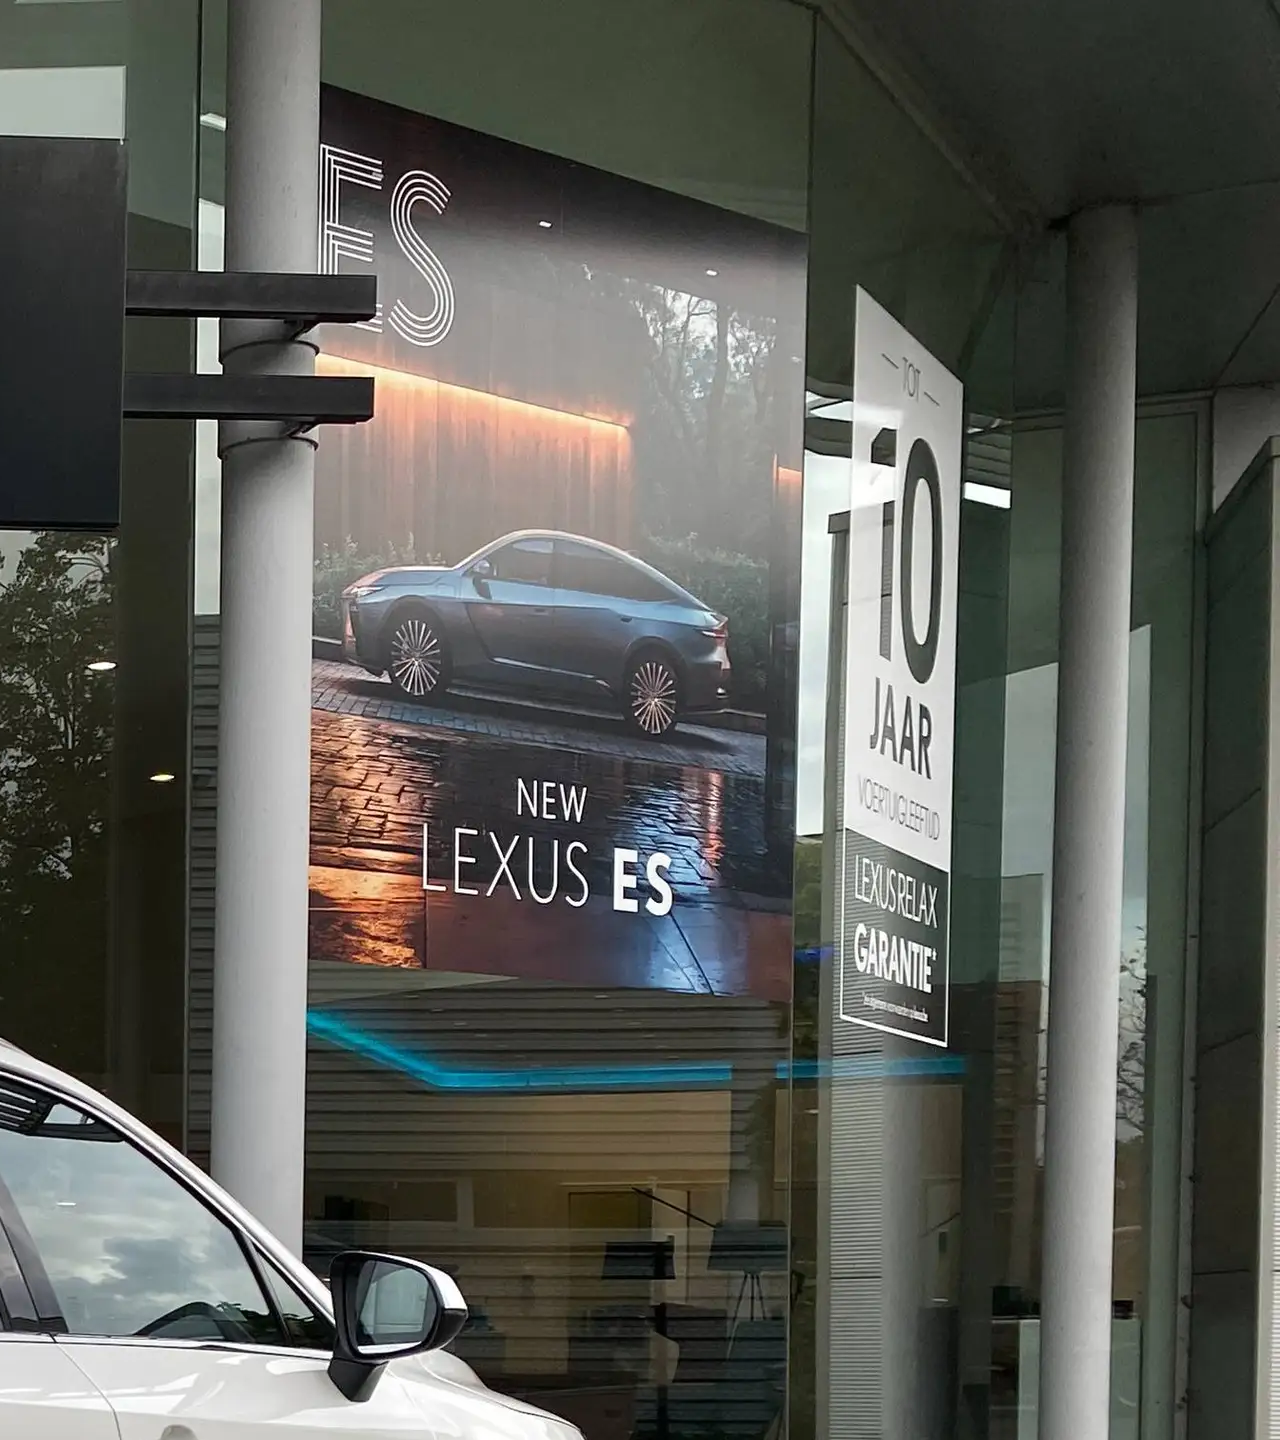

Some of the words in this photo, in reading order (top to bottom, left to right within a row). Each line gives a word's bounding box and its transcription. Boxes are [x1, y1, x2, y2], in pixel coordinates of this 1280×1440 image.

[317, 143, 455, 347] ES
[902, 356, 921, 404] TOT
[870, 427, 943, 684] 10
[870, 677, 932, 780] JAAR
[517, 777, 588, 824] NEW
[422, 823, 589, 908] LEXUS
[613, 847, 674, 916] ES
